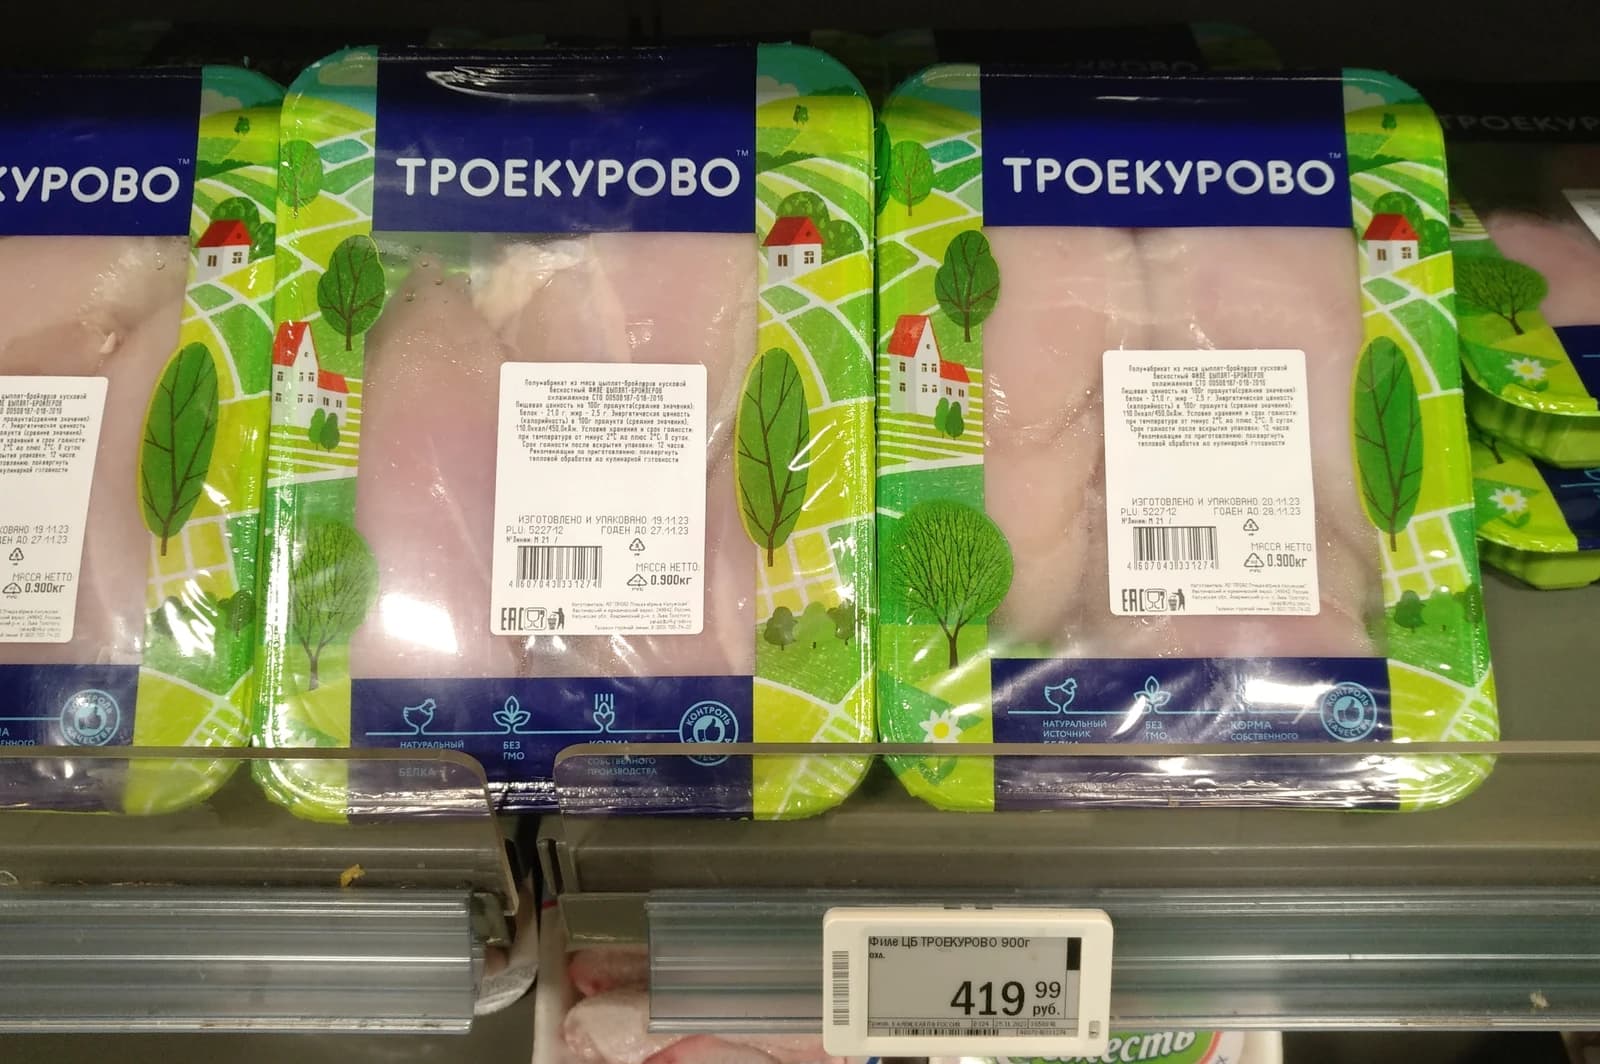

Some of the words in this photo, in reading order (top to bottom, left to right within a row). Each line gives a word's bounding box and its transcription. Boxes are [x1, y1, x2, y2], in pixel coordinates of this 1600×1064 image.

[395, 158, 740, 198] ТРОЕКУРОВО
[1002, 157, 1335, 196] ТРОЕКУРОВО
[1131, 497, 1194, 506] ИЗГОТОВЛЕНО
[1197, 497, 1204, 506] И
[1207, 497, 1258, 506] УПАКОВАНО
[1262, 497, 1300, 506] 20.11.23
[1142, 508, 1177, 516] 522712
[1213, 507, 1243, 516] ГОДЕН
[1246, 507, 1259, 516] ДО
[1262, 507, 1301, 516] 28.11.23
[518, 515, 582, 524] ИЗГОТОВЛЕНО
[585, 515, 592, 524] И
[595, 515, 647, 524] УПАКОВАНО
[652, 516, 689, 525] 19.11.23
[528, 526, 564, 535] 522712
[601, 526, 631, 535] ГОДЕН
[634, 526, 647, 535] ДО
[650, 526, 689, 535] 27.11.23
[1250, 542, 1281, 551] МАССА
[1266, 553, 1307, 568] 0.900кг
[635, 562, 666, 572] МАССА
[650, 574, 692, 586] 0.900кг
[24, 582, 66, 593] 0.900кг
[686, 705, 732, 727] КОНТРОЛЬ
[1042, 719, 1107, 729] НАТУРАЛЬНЫЙ
[1145, 720, 1163, 730] БЕЗ
[1230, 720, 1273, 731] КОРМА
[1042, 730, 1092, 739] ИСТОЧНИК
[1145, 731, 1168, 741] ГМО
[1230, 732, 1299, 742] СОБСТВЕННОГО
[400, 740, 464, 750] НАТУРАЛЬНЫЙ
[503, 741, 521, 750] БЕЗ
[503, 752, 525, 760] ГМО
[398, 768, 436, 777] БЕЛКА
[869, 937, 899, 947] Филе
[901, 937, 918, 949] ЦБ
[921, 937, 997, 948] ТРОЕКУРОВО
[1001, 938, 1031, 948] 900г
[868, 952, 886, 960] охл.
[1035, 981, 1061, 999] 99
[950, 980, 1025, 1017] 419
[1033, 1003, 1060, 1017] руб.
